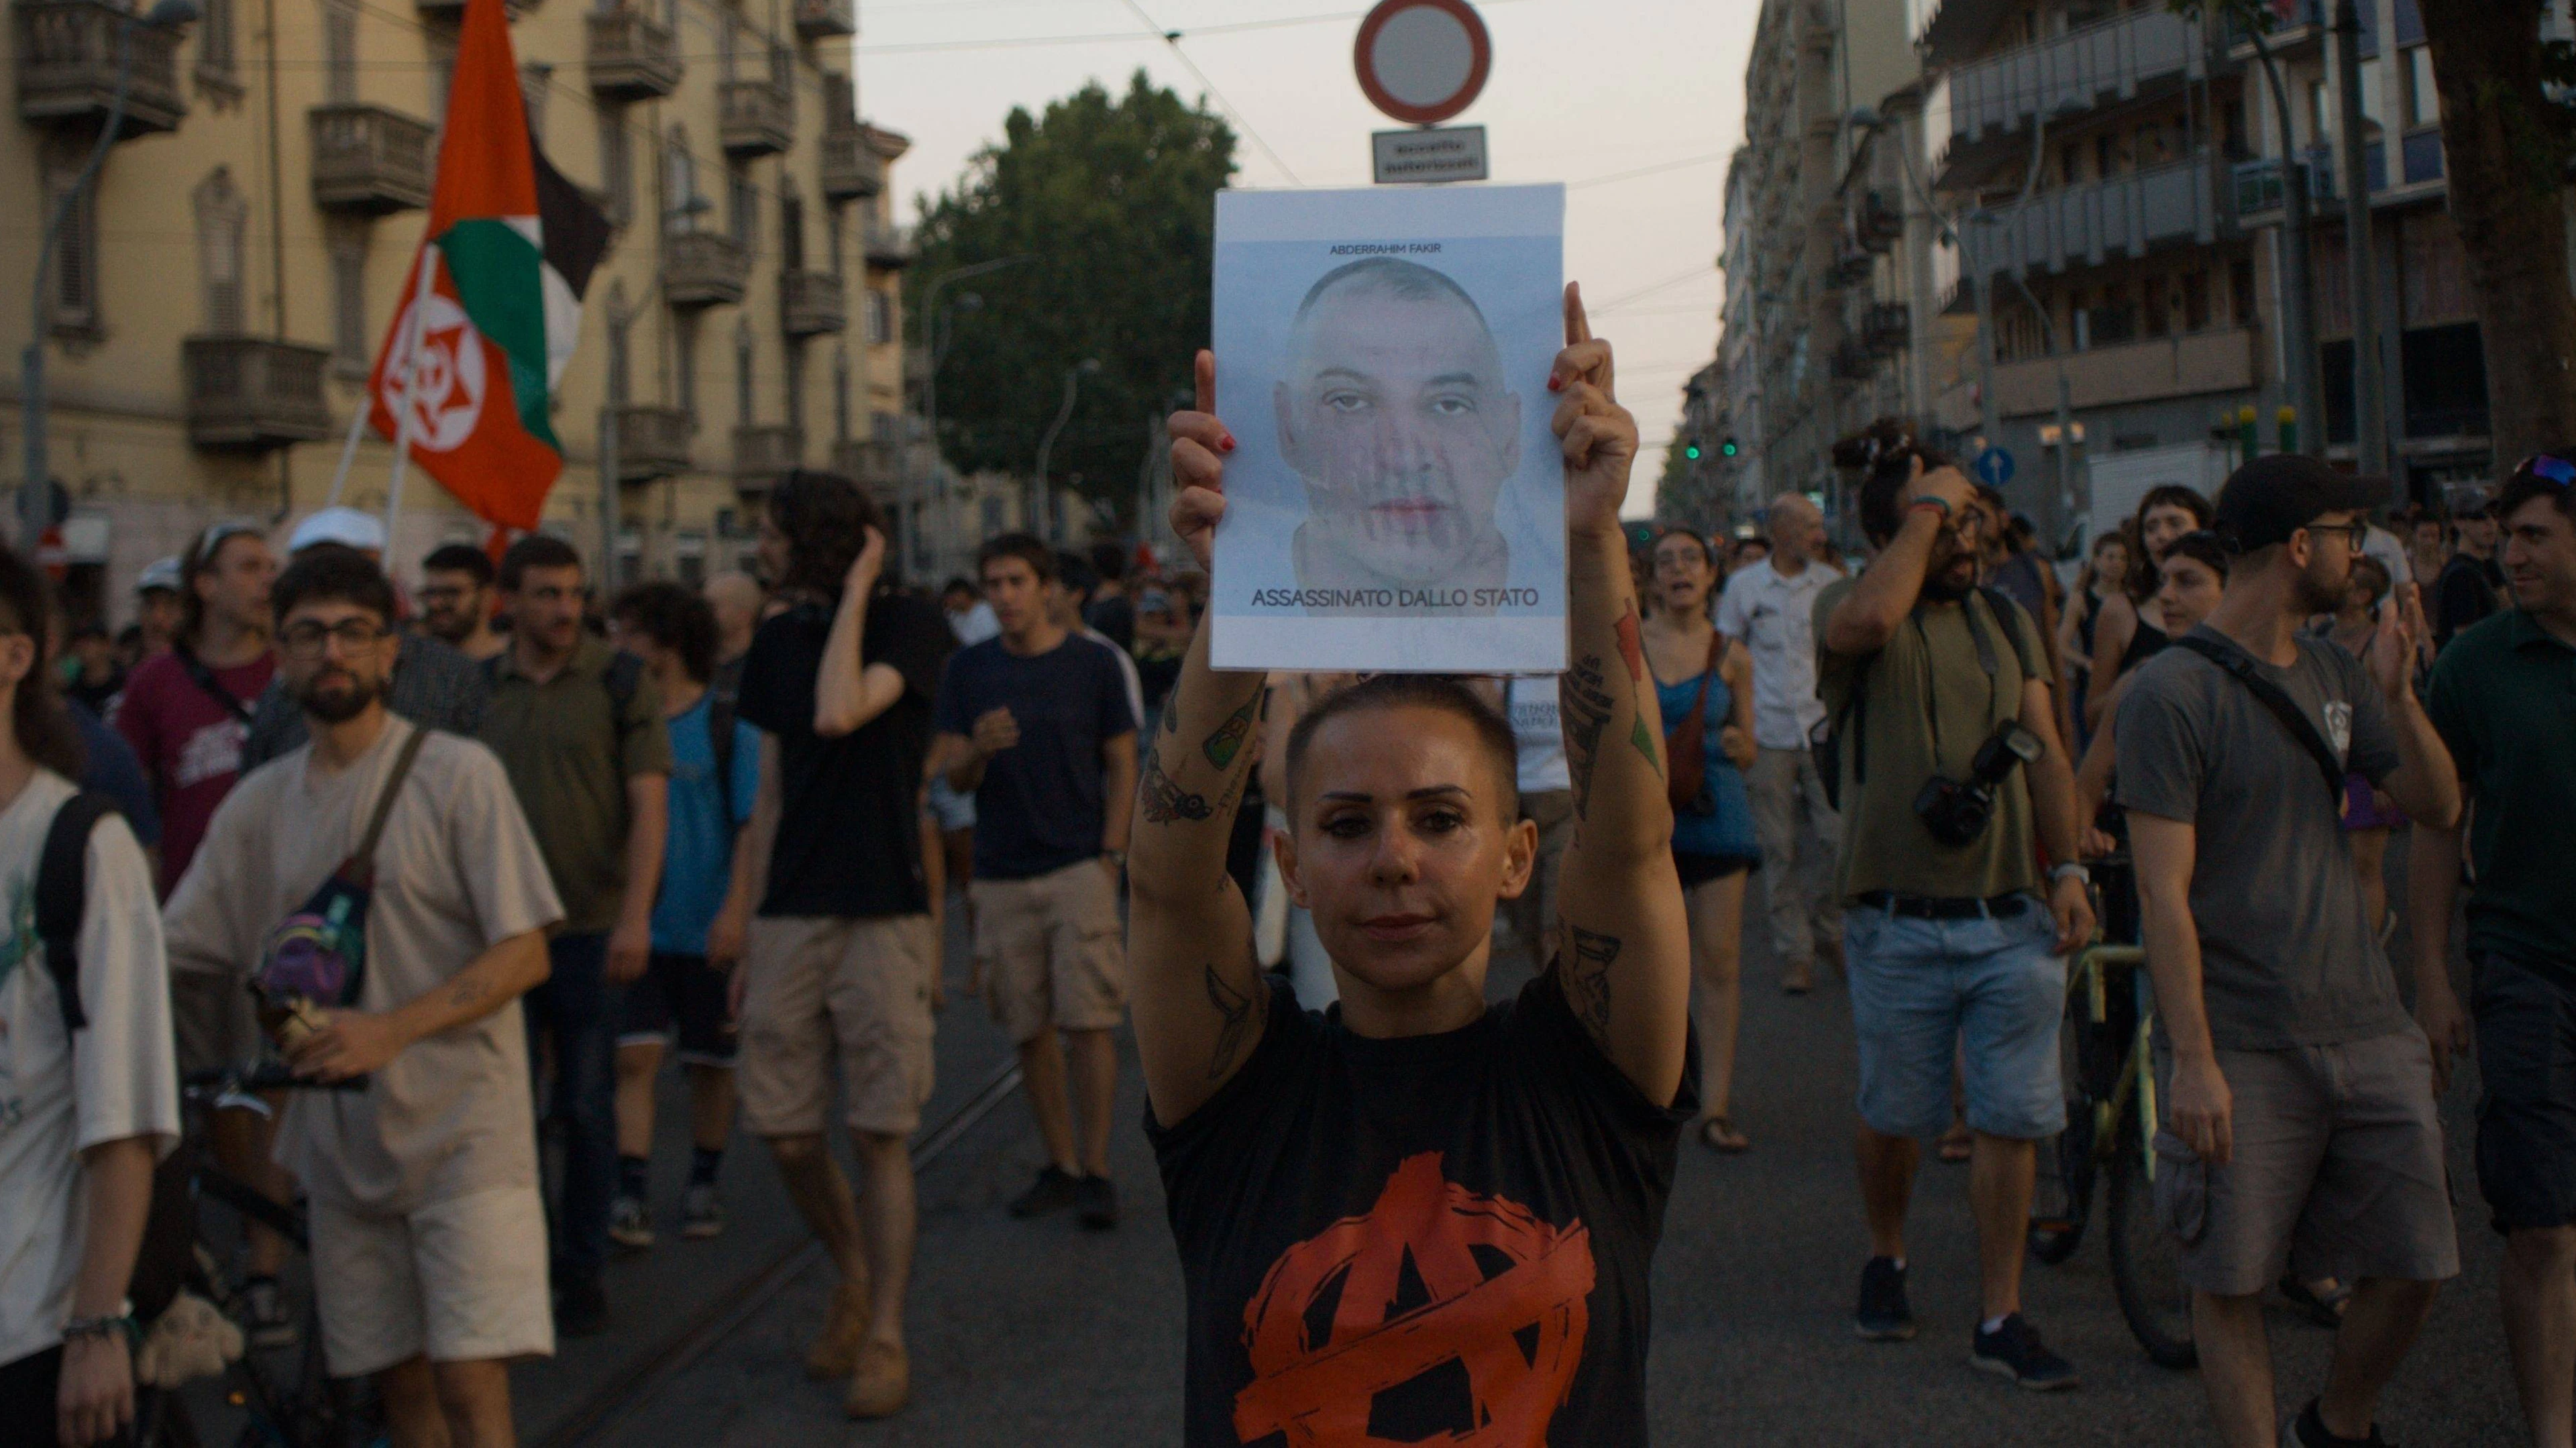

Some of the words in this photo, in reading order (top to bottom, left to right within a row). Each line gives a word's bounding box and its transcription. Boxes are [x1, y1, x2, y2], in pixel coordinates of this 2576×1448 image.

[1330, 243, 1406, 255] ABDERRAHIM
[1409, 243, 1442, 253] FAKIR
[1251, 589, 1393, 607] ASSASSINATO
[1399, 589, 1467, 607] DALLO
[1473, 588, 1539, 606] STATO
